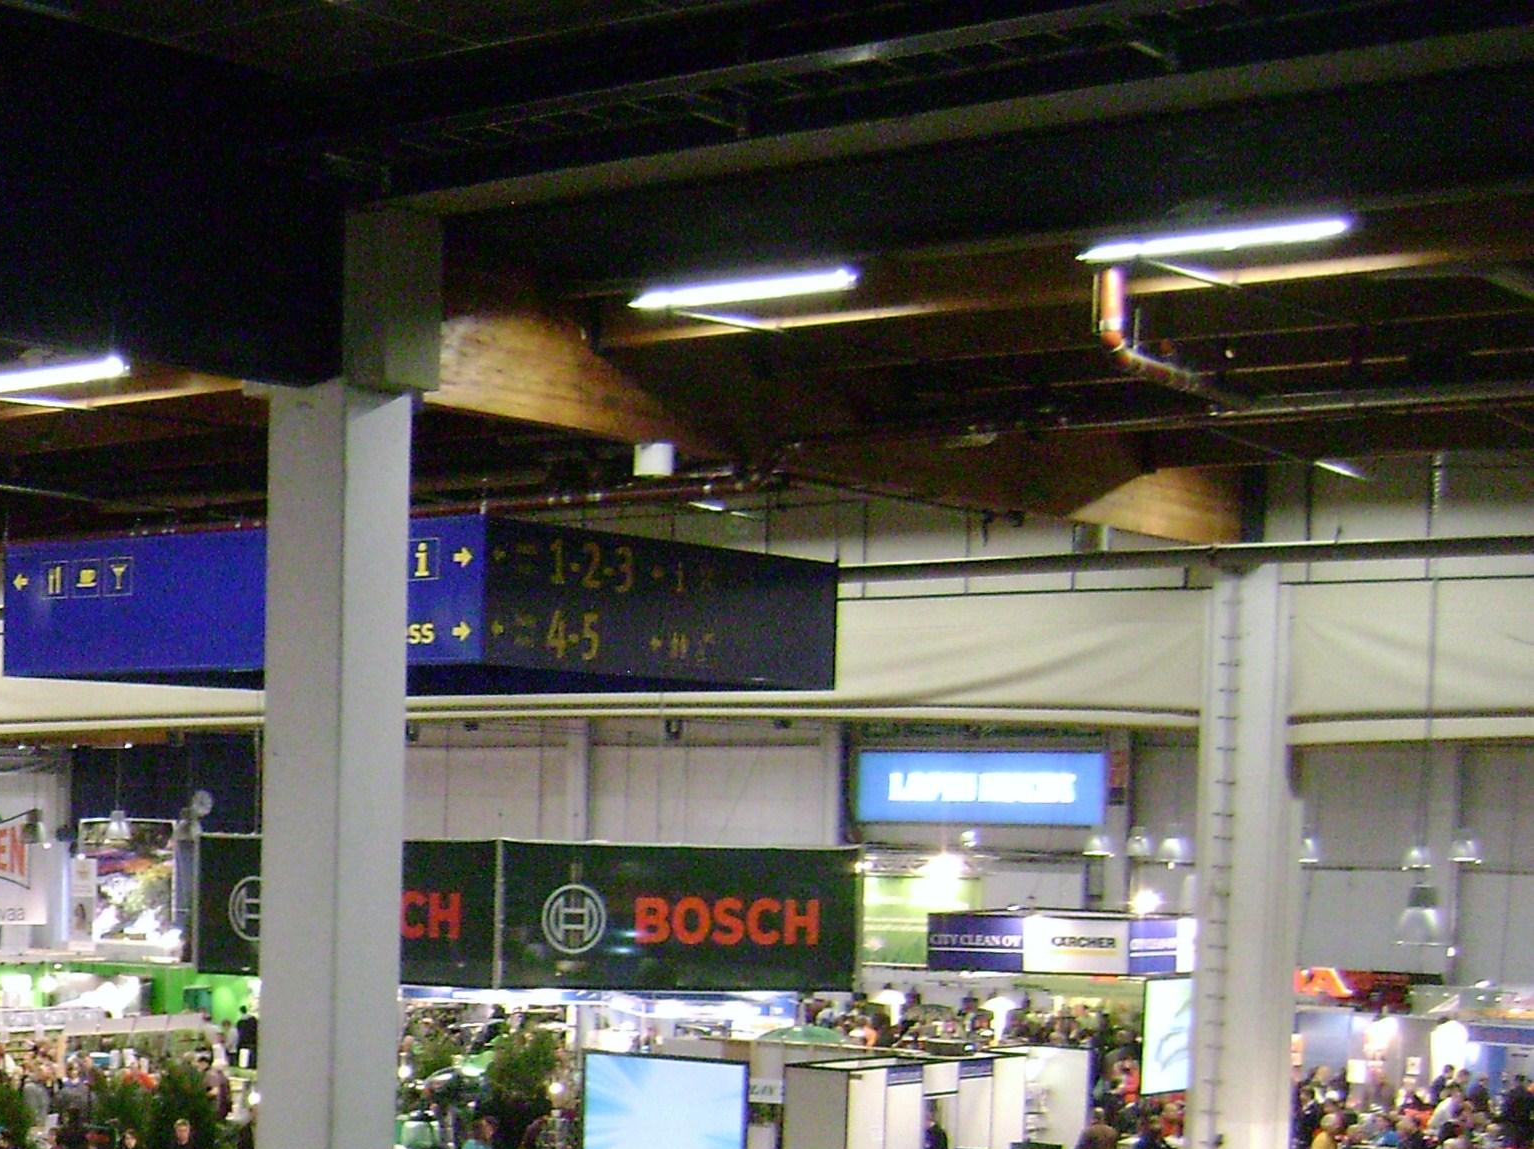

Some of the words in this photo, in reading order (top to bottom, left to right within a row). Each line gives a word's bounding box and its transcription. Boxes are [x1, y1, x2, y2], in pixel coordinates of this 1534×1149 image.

[633, 895, 820, 946] BOSCH
[929, 934, 959, 946] CITY
[960, 934, 1001, 947] CLEAN
